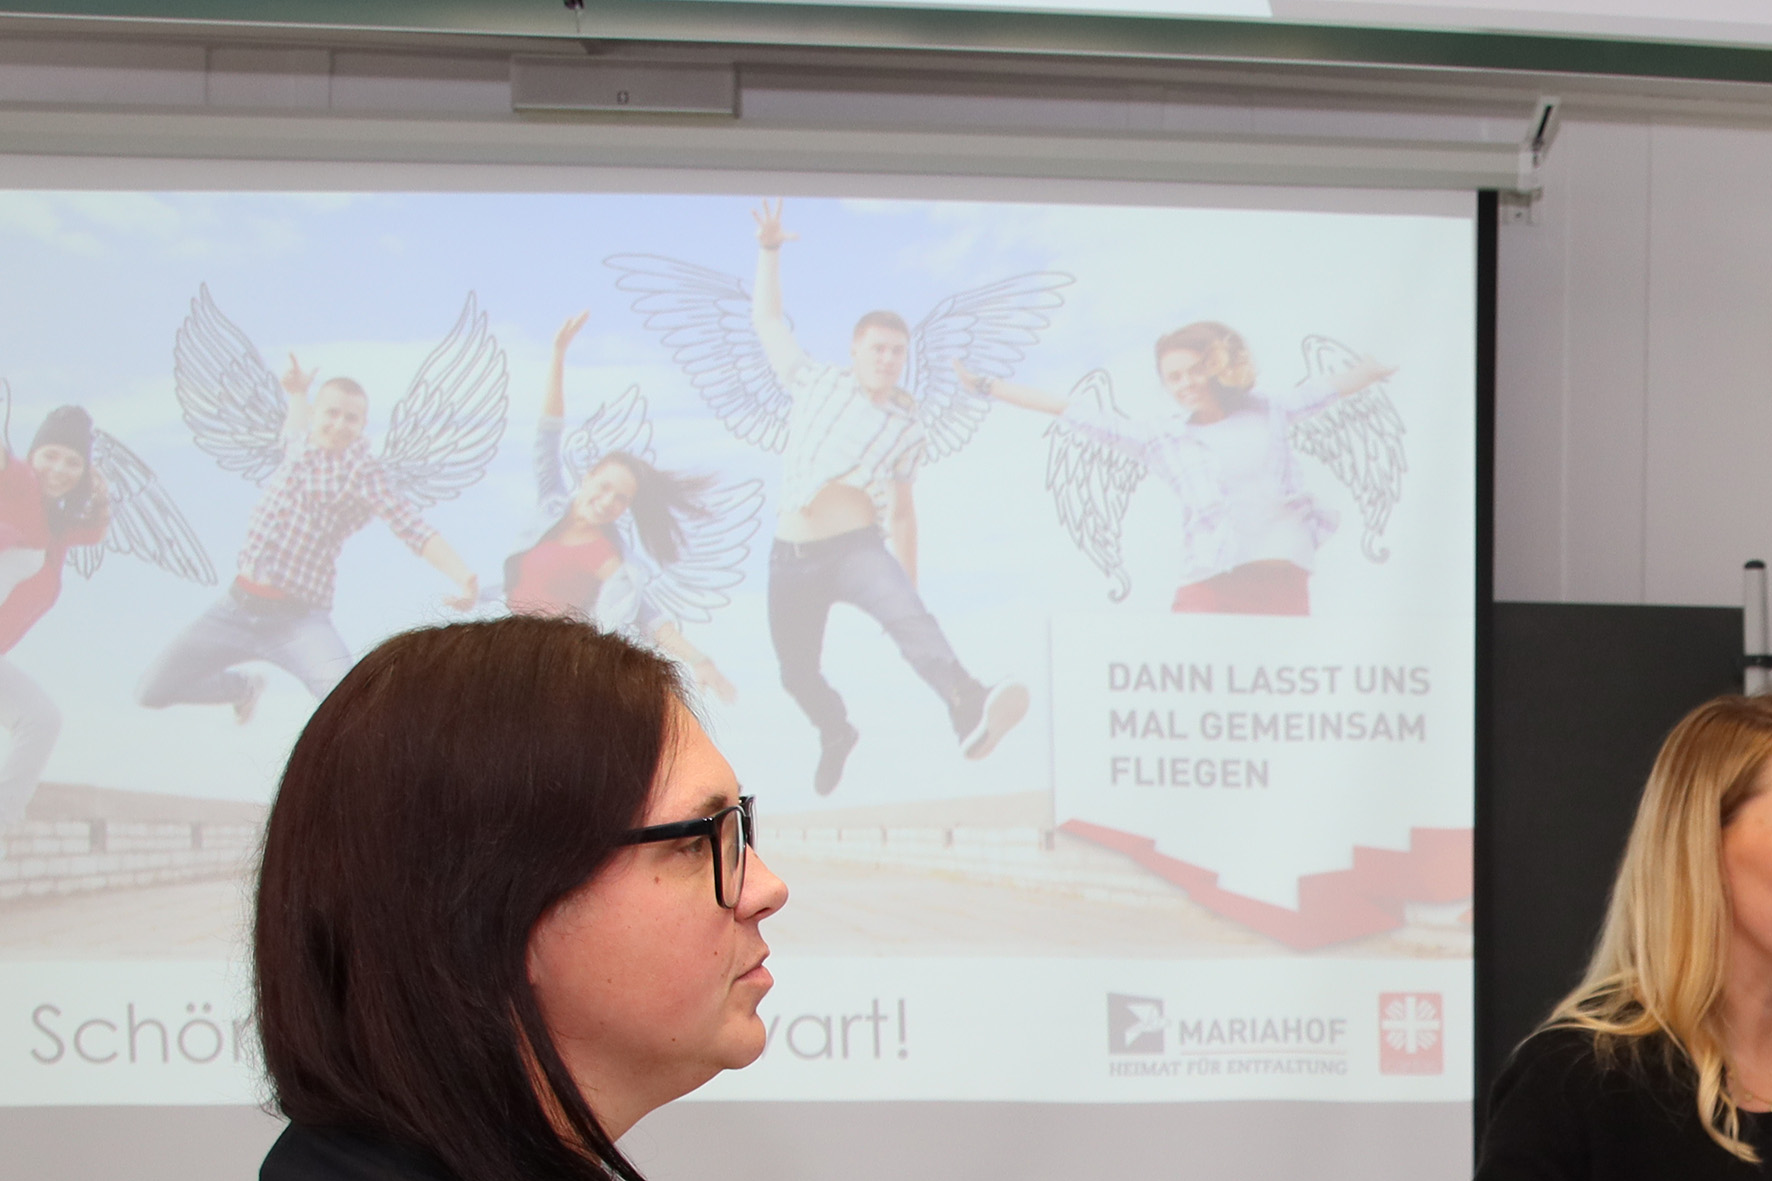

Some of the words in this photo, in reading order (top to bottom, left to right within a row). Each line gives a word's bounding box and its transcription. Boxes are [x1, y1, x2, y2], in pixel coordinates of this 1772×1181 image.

[1107, 662, 1214, 694] DANN
[1227, 664, 1343, 696] LASST
[1354, 665, 1431, 697] UNS
[1108, 709, 1188, 740] MAL
[1200, 711, 1427, 742] GEMEINSAM
[1110, 756, 1270, 789] FLIEGEN
[1178, 1016, 1348, 1046] MARIAHOF
[1108, 1059, 1181, 1078] HEIMAT
[1187, 1057, 1222, 1077] FÜR
[1226, 1058, 1348, 1078] ENTFALTUNG
